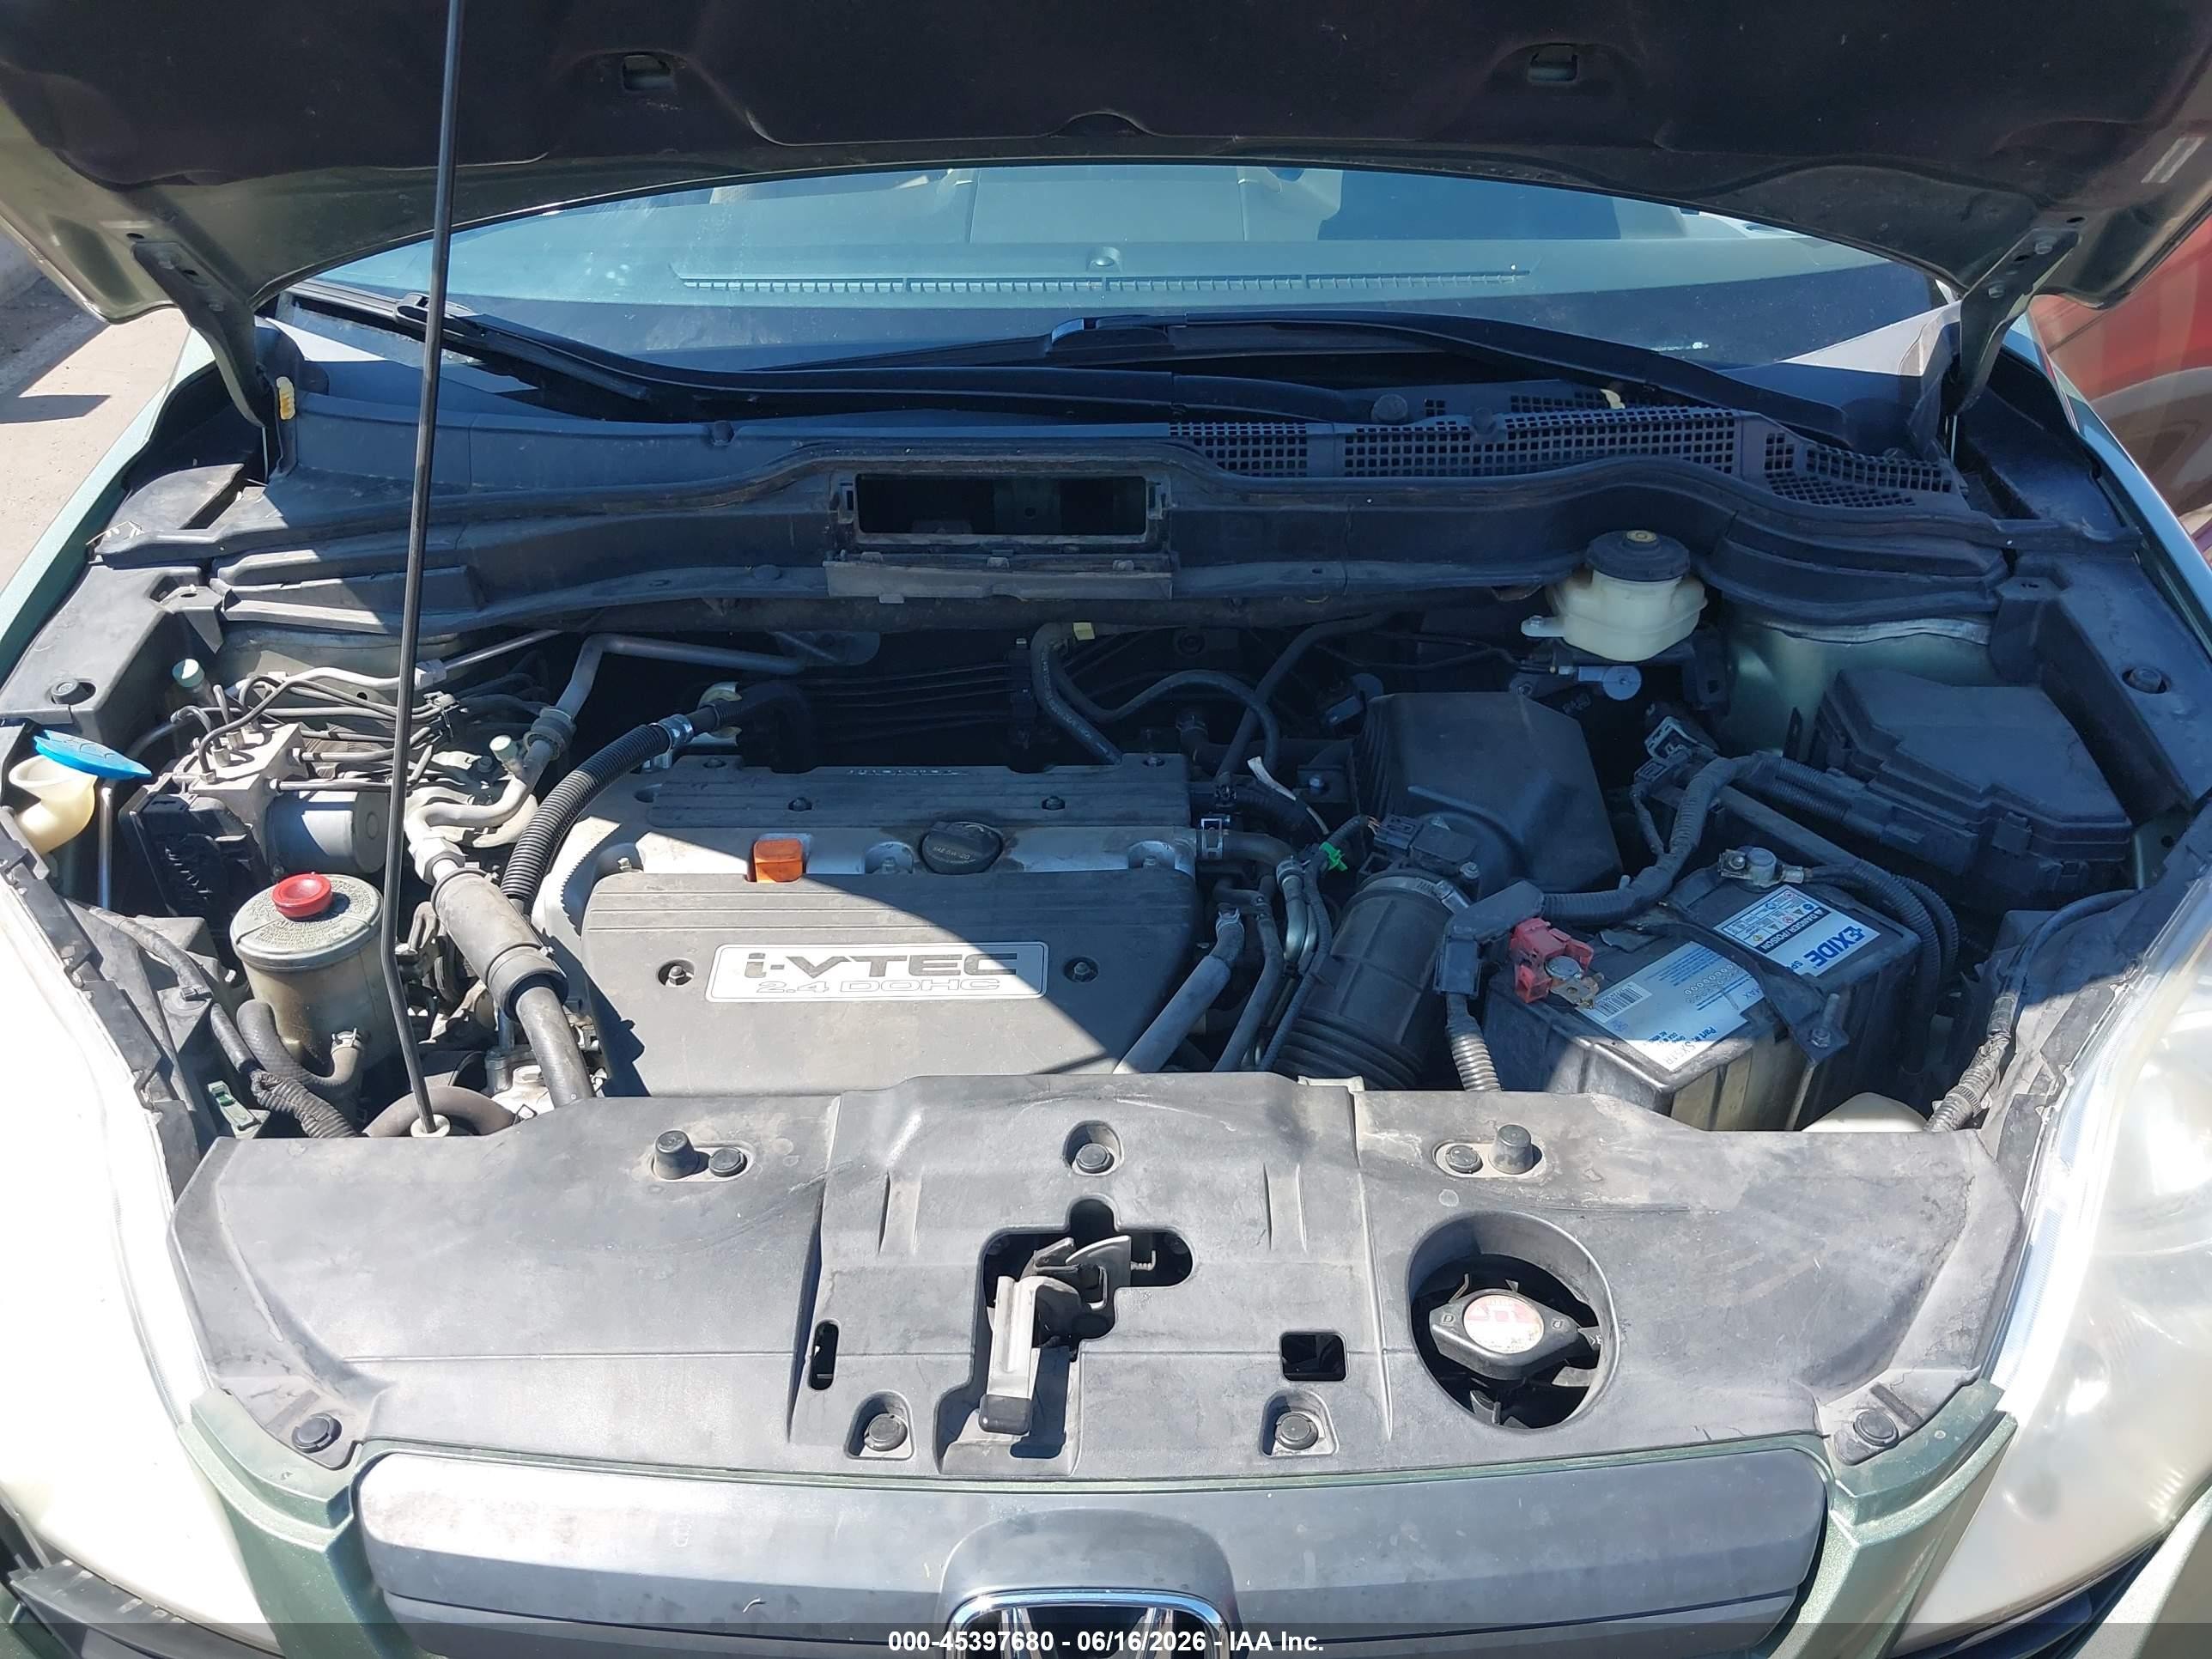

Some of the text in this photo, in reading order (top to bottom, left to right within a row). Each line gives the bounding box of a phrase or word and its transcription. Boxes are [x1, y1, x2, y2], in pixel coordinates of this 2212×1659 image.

[1802, 925, 1866, 967] EXIDE
[744, 953, 1017, 979] i-VTEC
[757, 979, 1000, 994] 2.4 DOHC
[1698, 1026, 1717, 1039] Part
